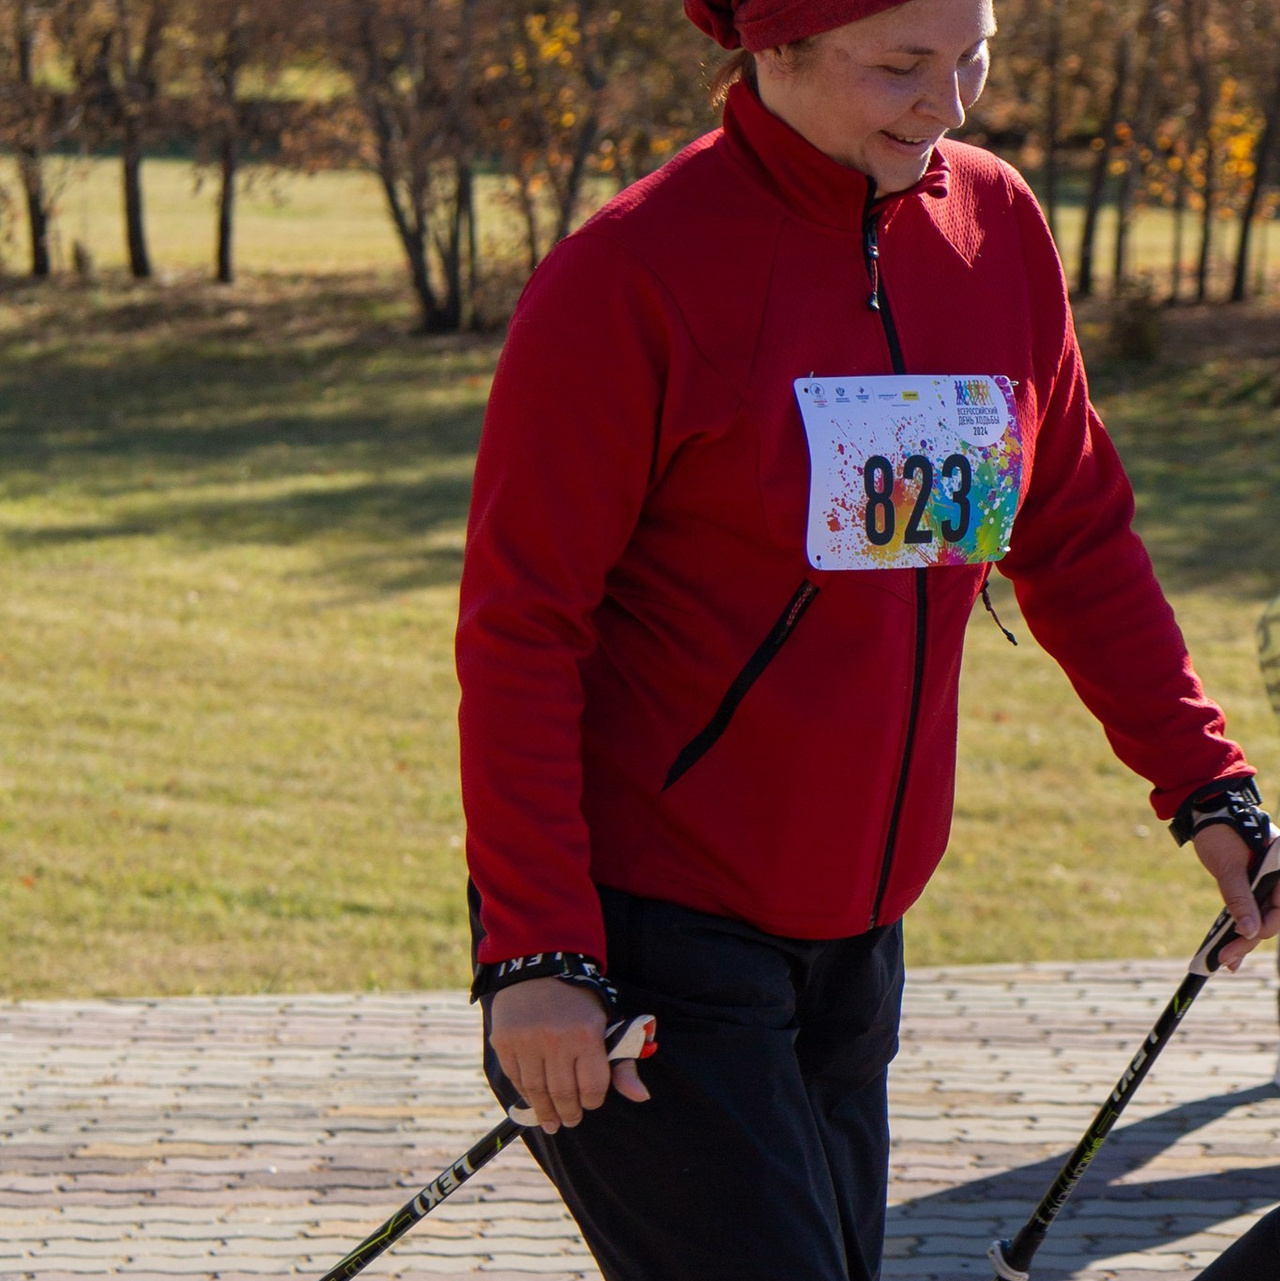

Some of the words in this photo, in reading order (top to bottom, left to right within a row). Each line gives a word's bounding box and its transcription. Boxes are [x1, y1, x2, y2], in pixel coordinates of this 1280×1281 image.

[956, 406, 999, 416] ВСЕРОССИЙСКИЙ
[958, 415, 975, 426] ДЕНЬ
[975, 415, 1001, 426] ХОДЬБЫ
[973, 426, 989, 436] 2024
[862, 453, 973, 547] 823
[413, 1153, 477, 1217] LEKI
